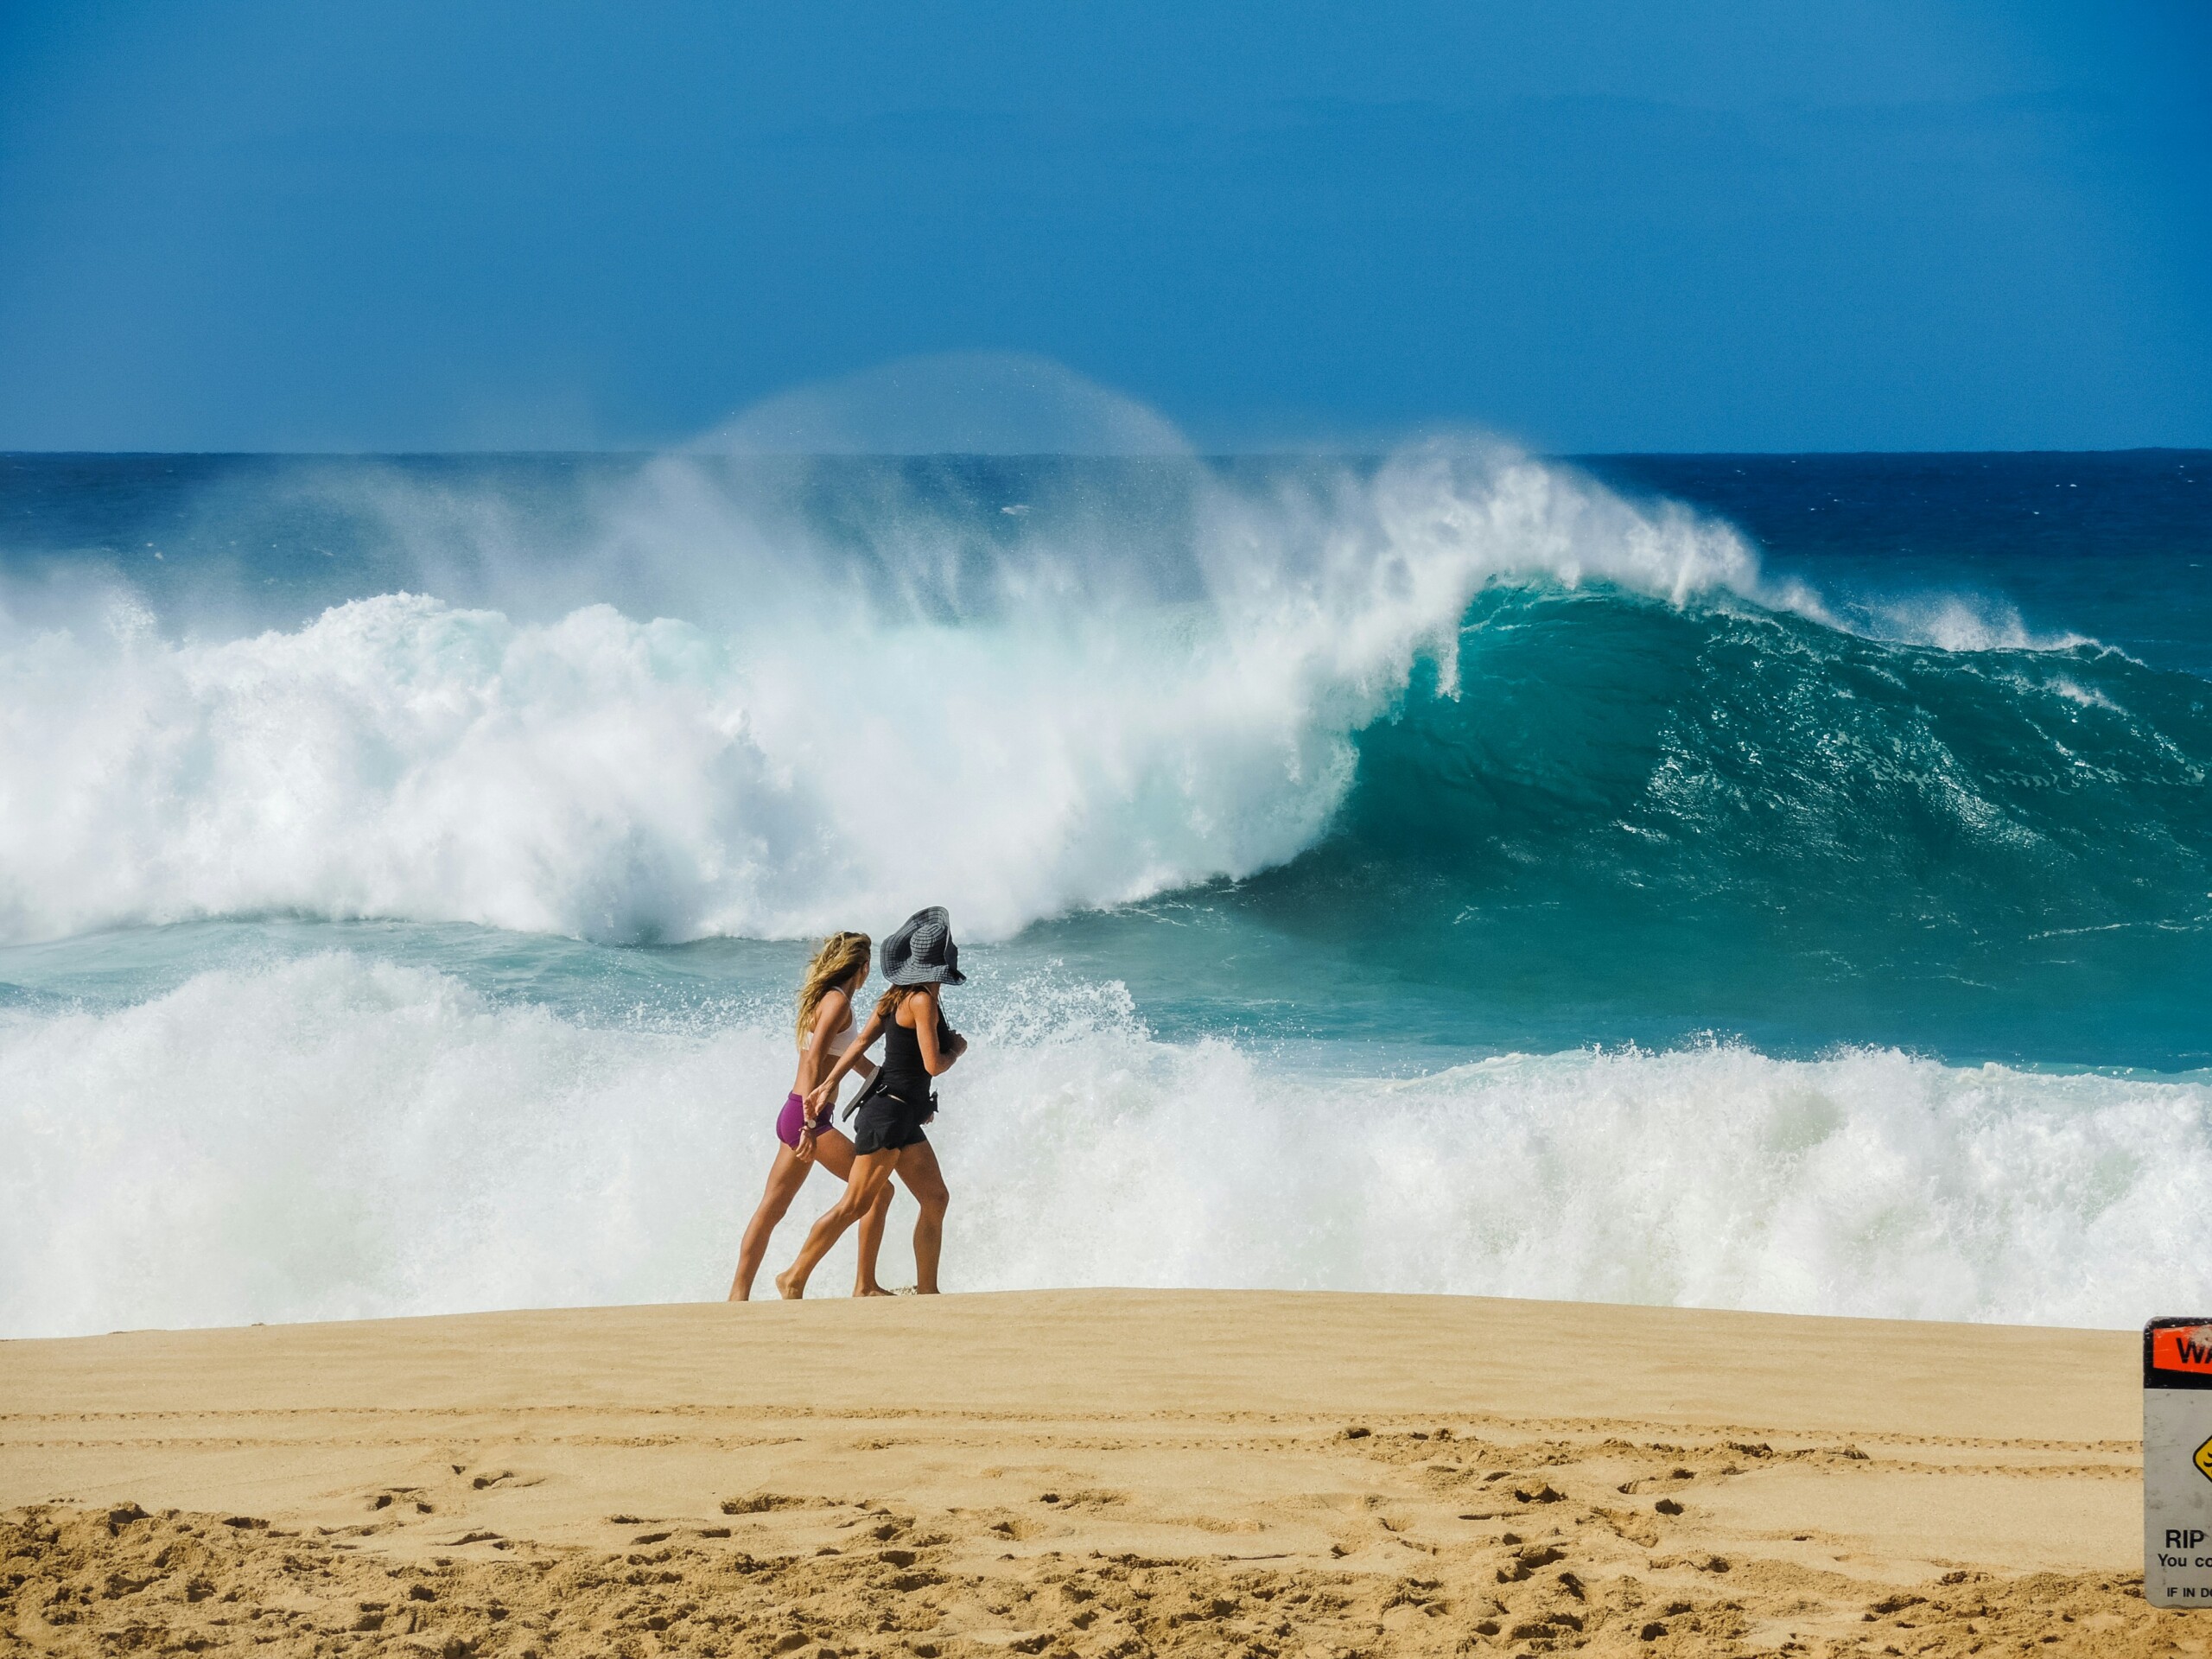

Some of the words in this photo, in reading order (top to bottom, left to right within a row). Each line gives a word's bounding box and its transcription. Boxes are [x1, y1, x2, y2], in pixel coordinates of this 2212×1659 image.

[2165, 1529, 2204, 1548] RIP
[2158, 1554, 2187, 1567] You
[2167, 1587, 2177, 1597] IF
[2183, 1588, 2195, 1597] IN
[2201, 1588, 2212, 1598] D
